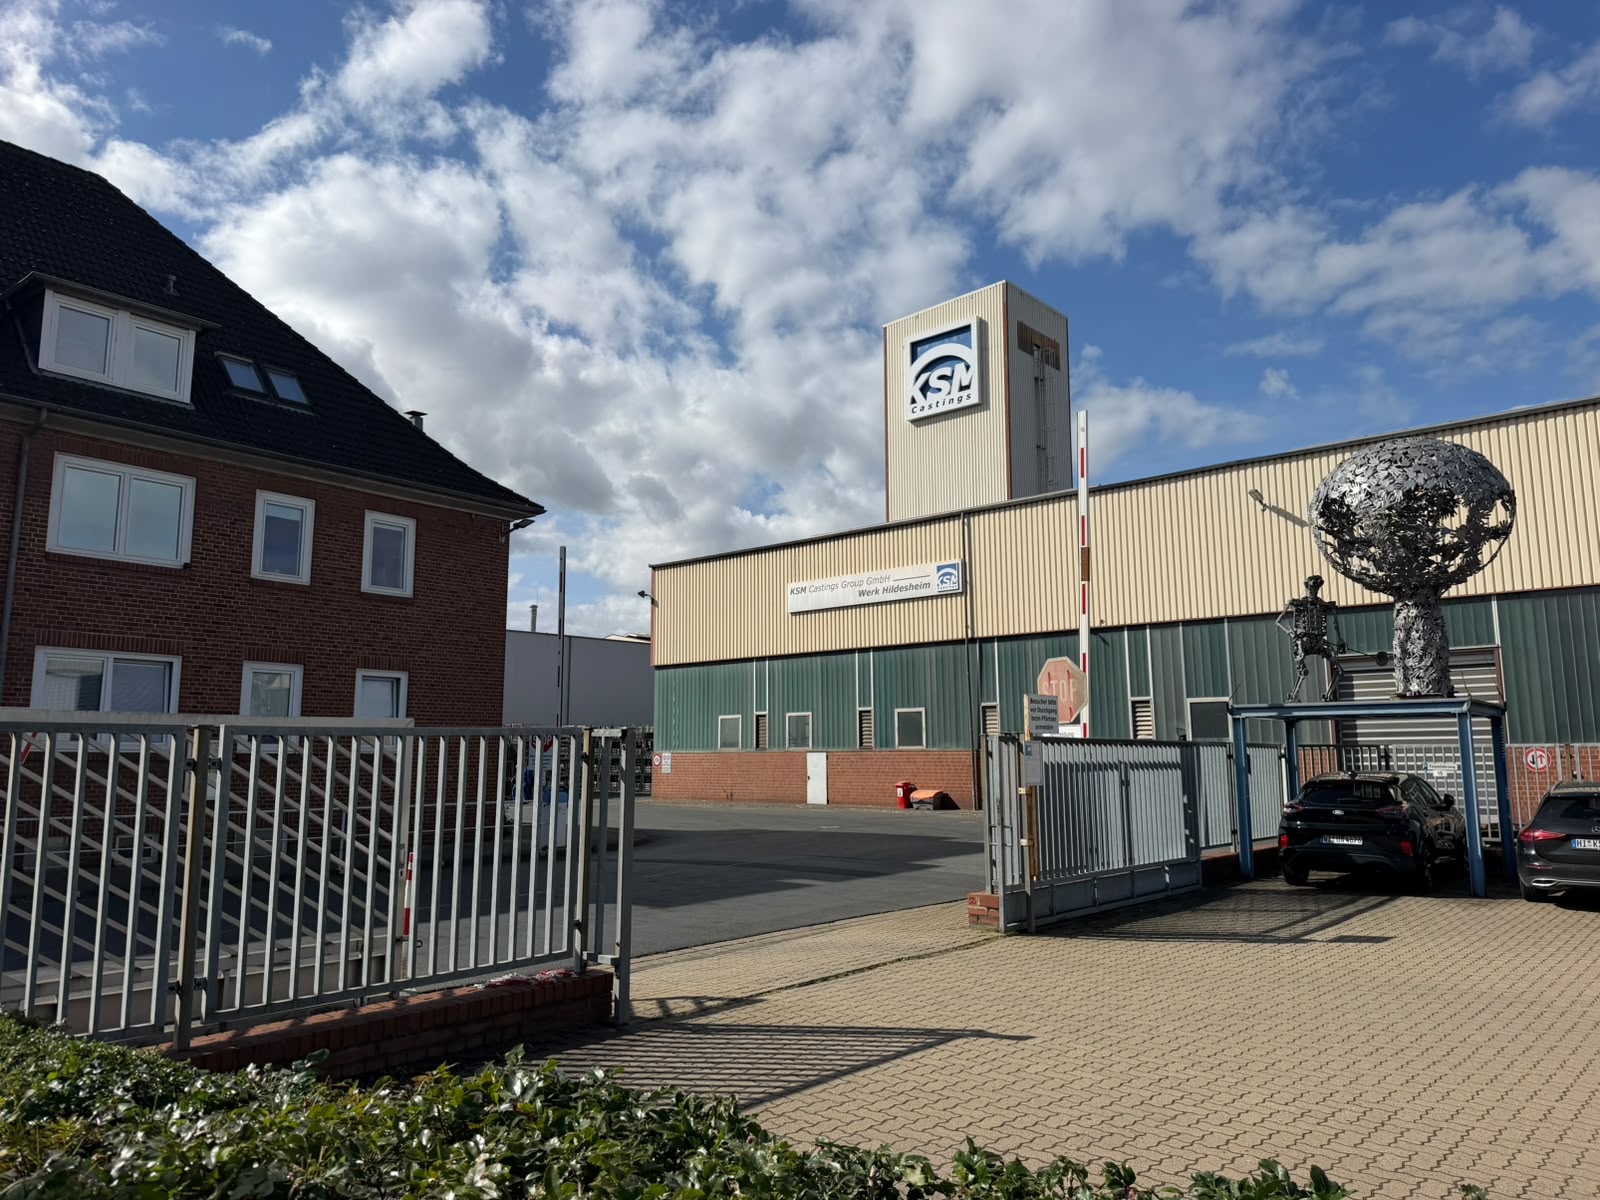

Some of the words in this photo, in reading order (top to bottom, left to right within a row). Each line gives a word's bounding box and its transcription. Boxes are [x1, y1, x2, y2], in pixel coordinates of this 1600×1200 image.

[911, 362, 975, 403] KSM
[911, 393, 972, 414] Castings
[790, 586, 807, 596] KSM
[808, 583, 839, 593] Castings
[841, 579, 864, 589] Group
[866, 574, 891, 586] GmbH
[858, 587, 880, 598] Werk
[882, 581, 931, 594] Hildesheim
[1042, 679, 1079, 703] STOP
[1037, 707, 1058, 715] Durchgang
[1577, 839, 1586, 848] HI
